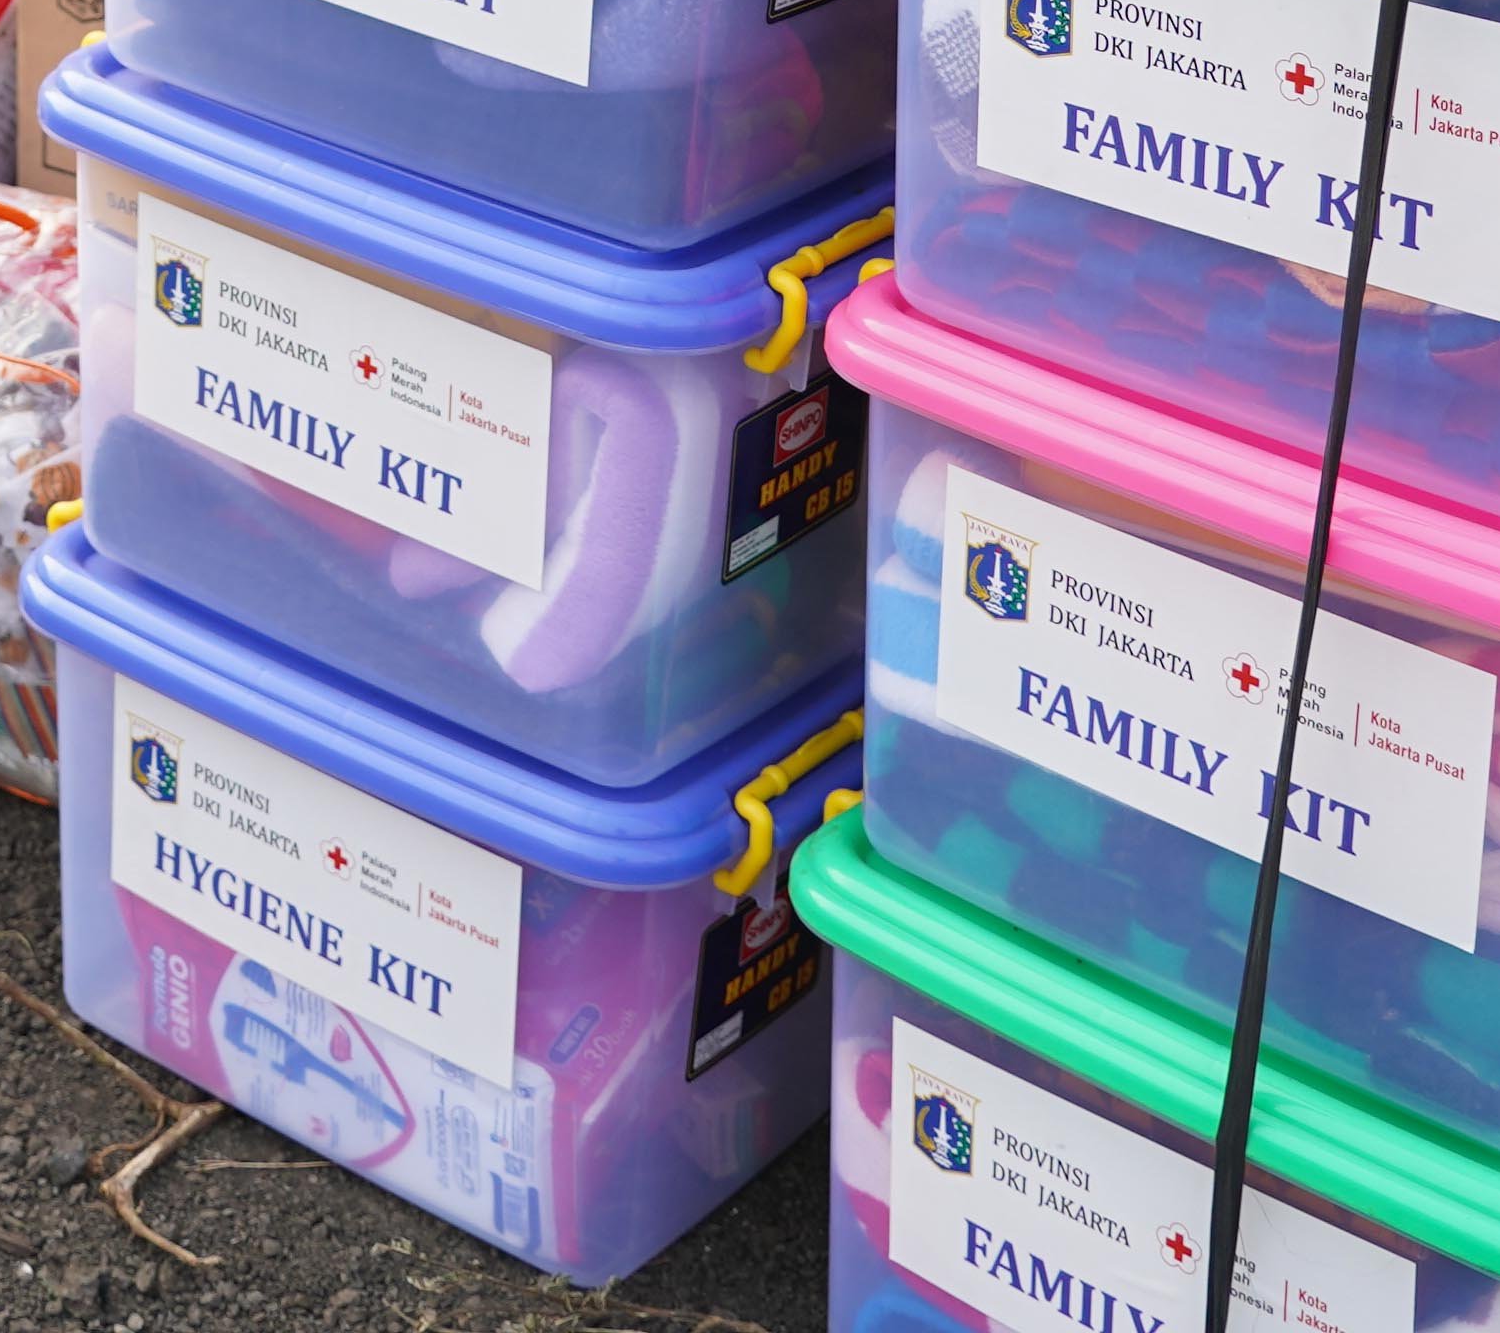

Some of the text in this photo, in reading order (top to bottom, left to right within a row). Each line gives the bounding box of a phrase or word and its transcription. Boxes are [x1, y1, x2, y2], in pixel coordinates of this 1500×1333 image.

[1093, 32, 1247, 91] DKI JAKARTA
[1333, 82, 1370, 102] Mera
[1430, 94, 1463, 116] Kota
[1428, 116, 1484, 145] Jakarta
[1062, 102, 1285, 209] FAMILY
[219, 280, 297, 328] PROVINSI
[218, 311, 329, 372] DKI JAKARTA
[391, 372, 423, 394] Merah
[392, 357, 427, 382] Palang
[390, 388, 442, 417] Indonesia
[460, 390, 483, 410] Kota
[196, 365, 462, 515] FAMILY KIT
[458, 408, 531, 447] Jakarta Pusat
[781, 408, 821, 444] SHINPO
[759, 441, 838, 509] HANDY
[805, 470, 855, 521] CB 15
[1050, 569, 1154, 628] PROVINSI
[1048, 603, 1194, 682] DKI JAKARTA
[1017, 666, 1228, 796] FAMILY
[1370, 710, 1401, 734] Kota
[1368, 732, 1466, 781] Jakarta Pusat
[194, 762, 270, 814] PROVINSI
[193, 791, 301, 860] DKI JAKARTA
[361, 866, 393, 889] Merah
[362, 851, 397, 878] Palang
[360, 880, 410, 913] Indonesia
[429, 889, 452, 910] Kota
[155, 832, 452, 1017] HYGIENE KIT
[428, 905, 499, 949] Jakarta Pusat
[169, 955, 191, 1050] GENIO
[993, 1127, 1091, 1193] PROVINSI
[992, 1161, 1131, 1247] DKI JAKARTA
[1298, 1288, 1328, 1314] Kota
